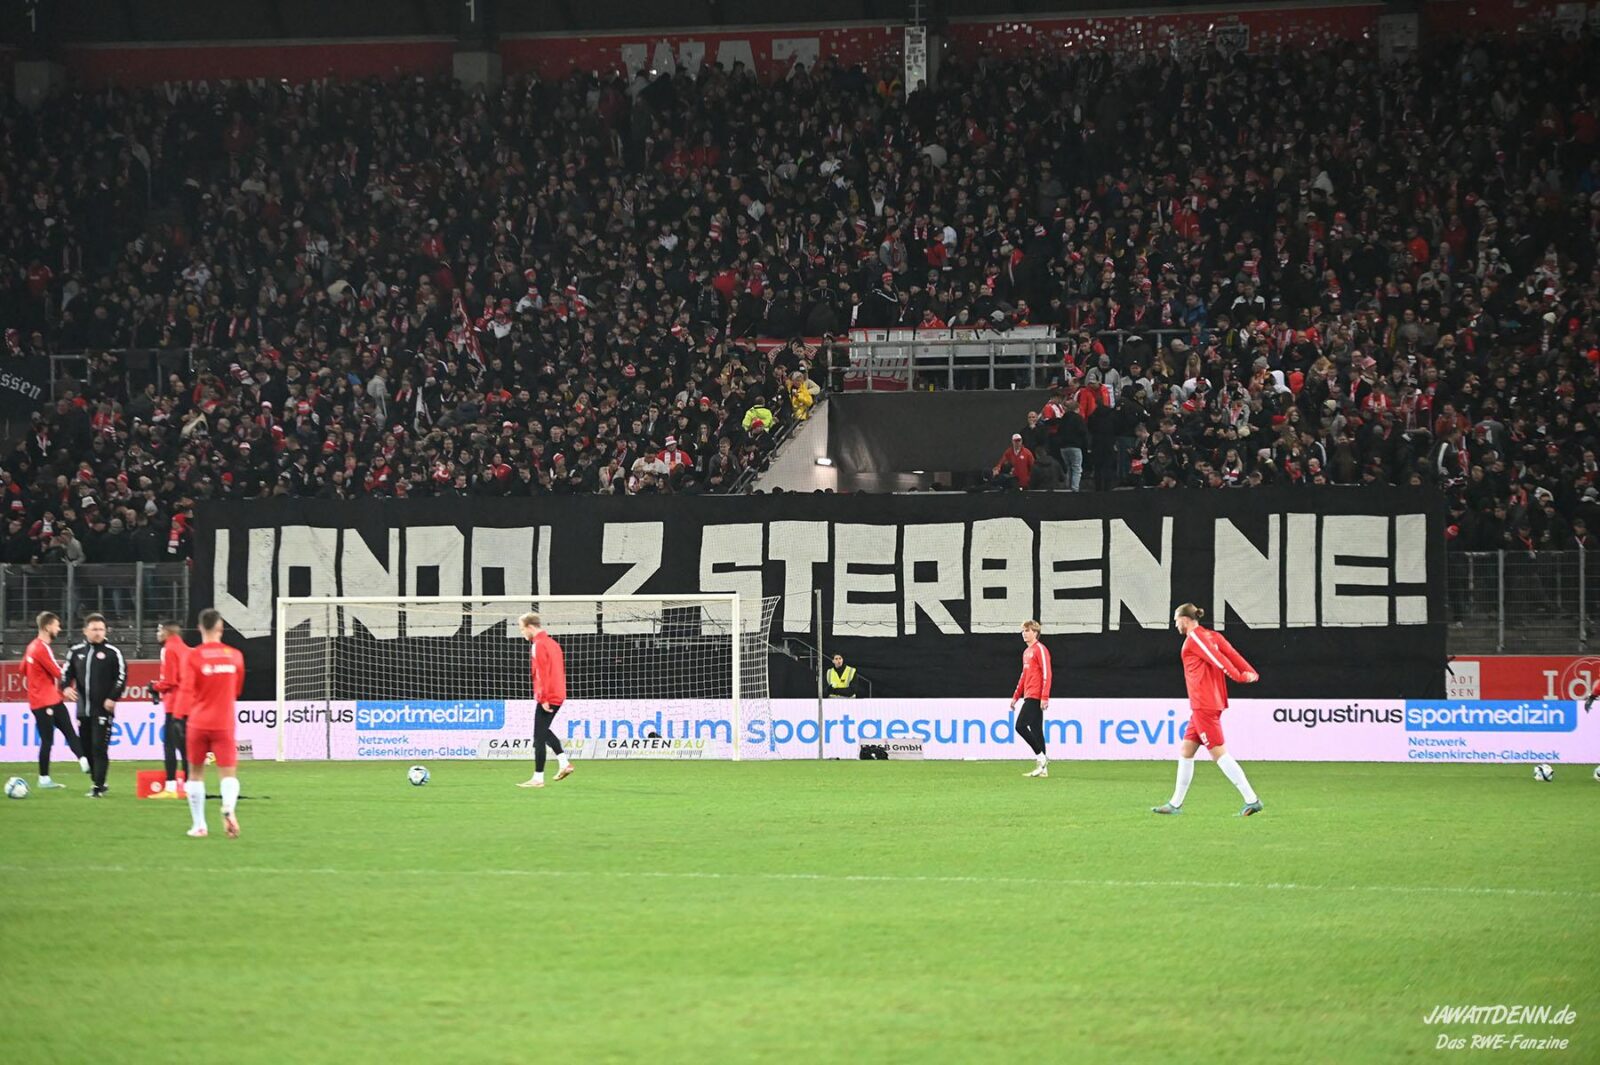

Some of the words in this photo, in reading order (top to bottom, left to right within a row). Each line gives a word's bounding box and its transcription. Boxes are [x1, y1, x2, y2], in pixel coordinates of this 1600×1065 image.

[0, 372, 42, 399] ssen
[700, 514, 1174, 640] STERBEN
[1213, 512, 1428, 631] NIE!
[1450, 675, 1473, 684] ADT
[1450, 689, 1474, 697] SEN
[358, 704, 496, 728] sportmedizin
[1273, 703, 1403, 728] augustinus
[1407, 704, 1565, 729] sportmedizin
[567, 711, 732, 744] rundum
[747, 710, 1015, 752] sportgesund
[358, 734, 409, 744] Netzwerk
[607, 739, 705, 749] GARTENBAU
[1408, 736, 1467, 748] Netzwerk
[357, 746, 478, 758] Gelsenkirchen-Gladbe
[1407, 749, 1560, 760] Gelsenkirchen-Gladbeck
